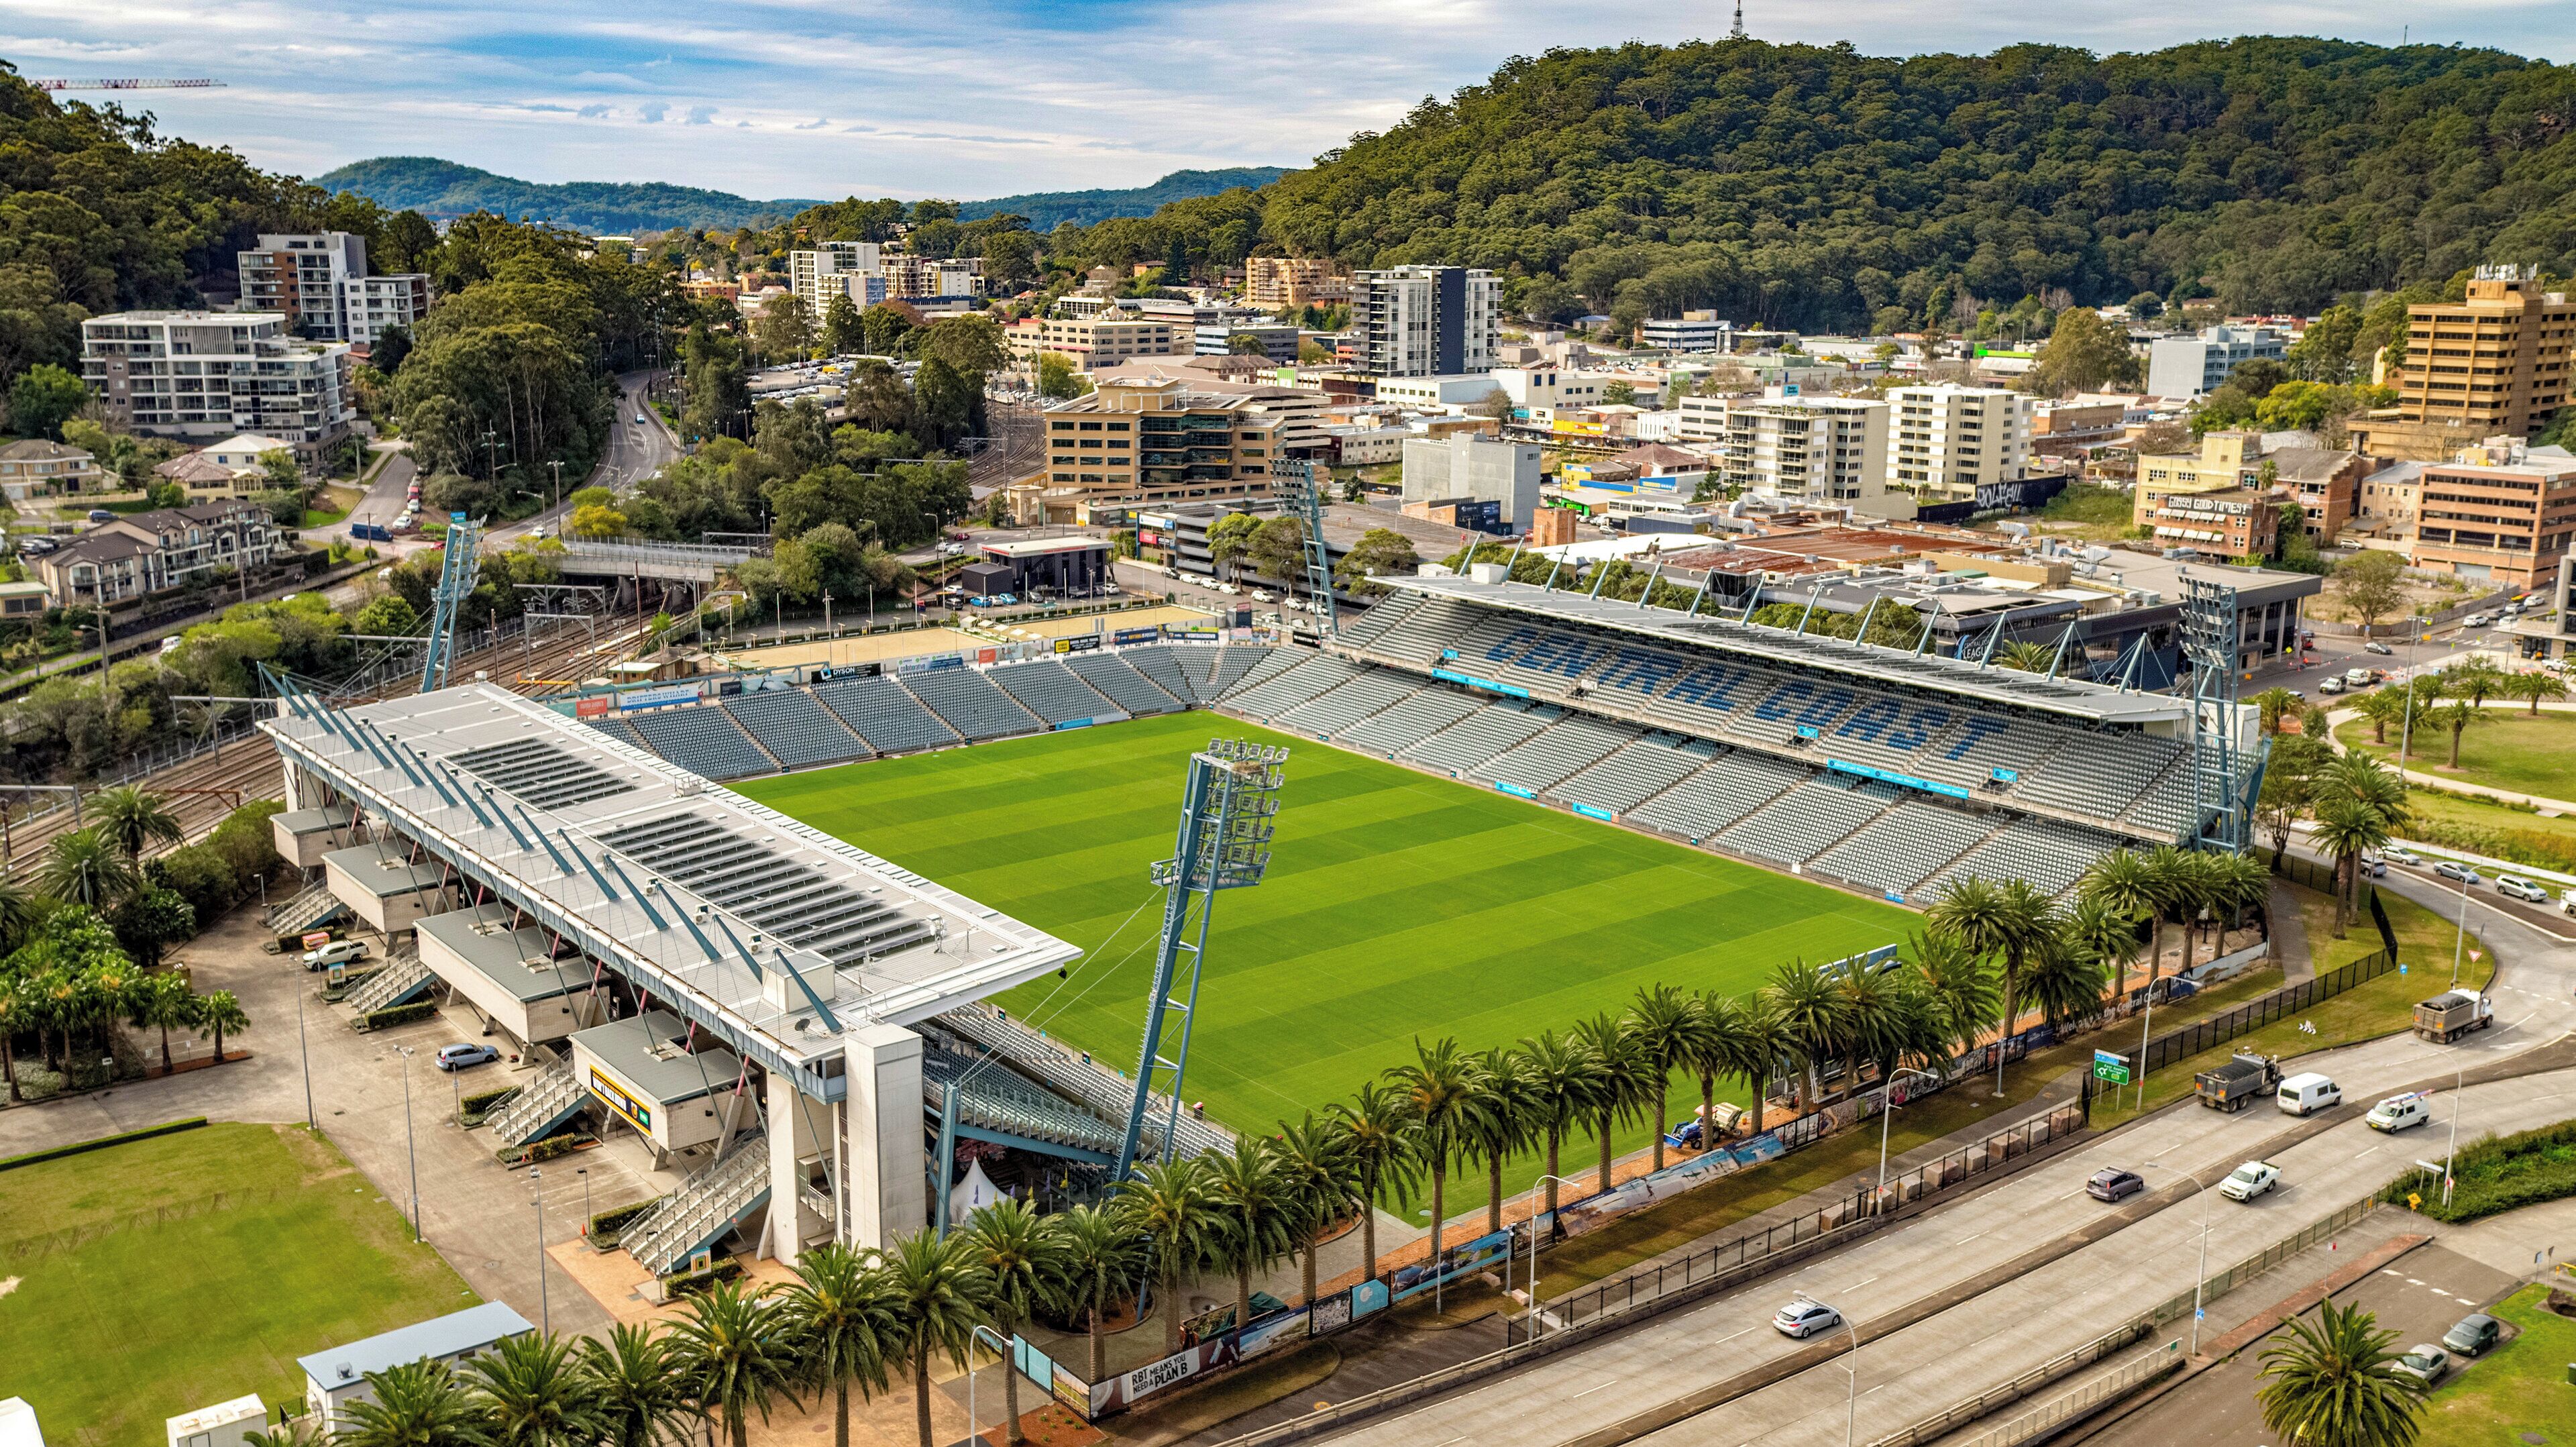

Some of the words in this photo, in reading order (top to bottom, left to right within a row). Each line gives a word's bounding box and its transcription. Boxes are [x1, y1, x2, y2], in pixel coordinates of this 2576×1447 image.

[2194, 498, 2214, 510] GOOD
[2214, 500, 2247, 515] TIMES!
[833, 667, 855, 676] DYSON
[627, 692, 662, 703] DRIFTERS
[662, 690, 689, 699] WHARF
[1485, 628, 1750, 711] CENTRAL
[1754, 680, 2010, 761] COAST
[2104, 1004, 2116, 1018] the
[2117, 994, 2143, 1012] Central
[1132, 1369, 1148, 1385] RBT
[1150, 1360, 1172, 1377] MEANS
[1173, 1354, 1186, 1365] YOU
[1133, 1381, 1148, 1394] NEED
[1155, 1367, 1179, 1387] PLAN
[1181, 1362, 1187, 1375] B
